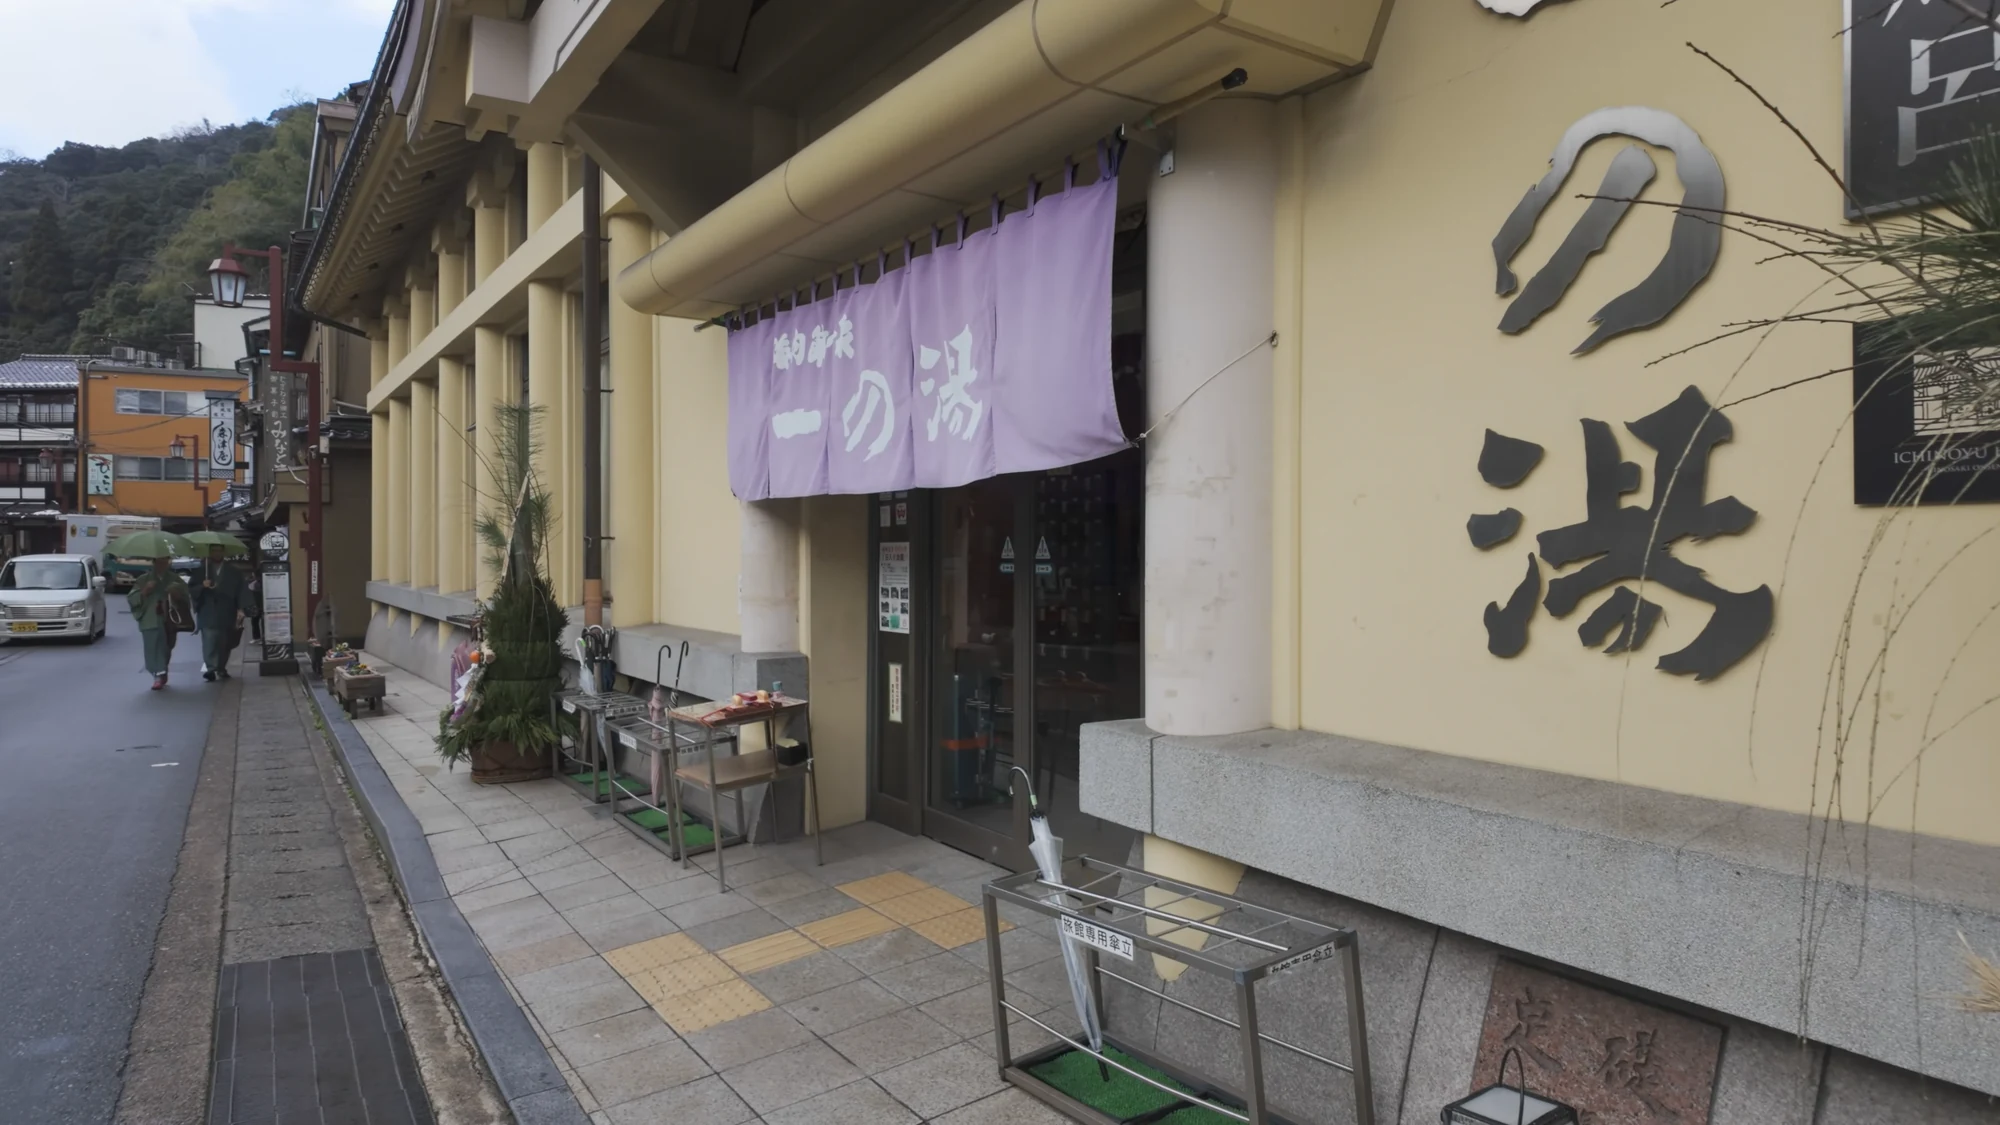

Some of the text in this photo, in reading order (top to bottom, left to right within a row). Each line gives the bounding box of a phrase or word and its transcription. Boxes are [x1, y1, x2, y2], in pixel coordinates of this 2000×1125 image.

[1467, 0, 1773, 682] の湯
[772, 324, 983, 462] 一の湯
[1893, 447, 1988, 464] ICHINOYU
[1932, 465, 1970, 473] INOSAKI
[1063, 917, 1132, 957] 旅館専用傘立
